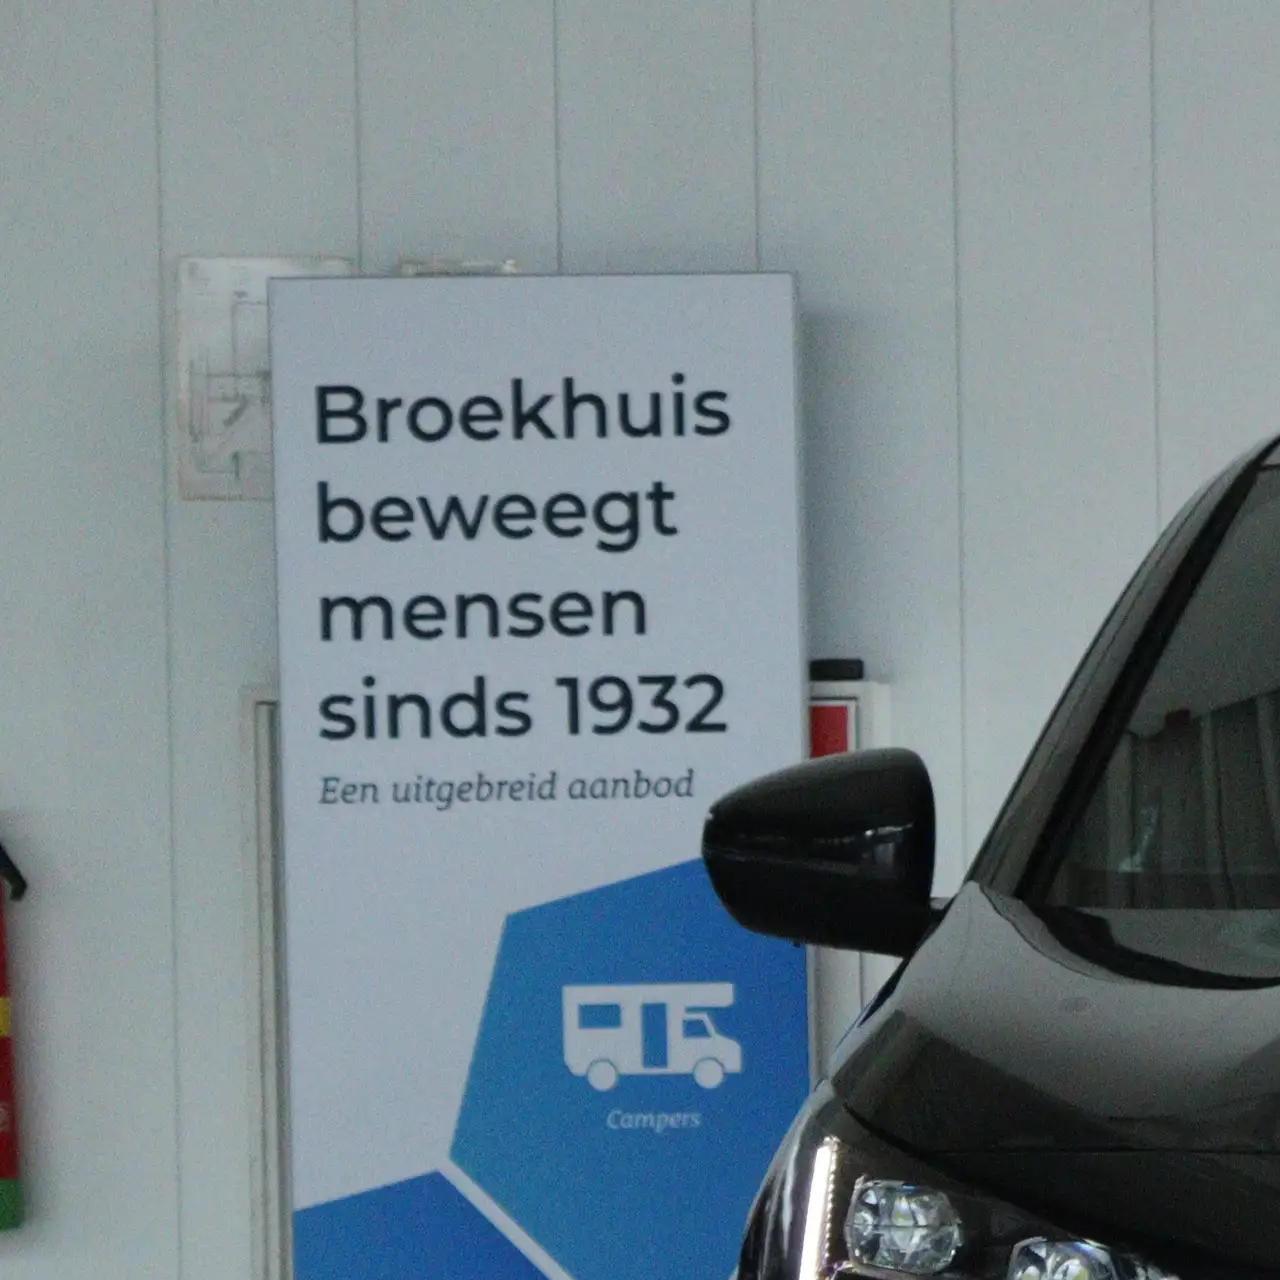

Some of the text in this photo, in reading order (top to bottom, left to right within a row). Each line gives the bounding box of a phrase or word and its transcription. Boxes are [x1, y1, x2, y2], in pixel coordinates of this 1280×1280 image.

[315, 373, 731, 444] Broekhuis
[317, 480, 678, 553] beweegt
[321, 590, 647, 642] mensen
[319, 673, 728, 740] sinds 1932
[319, 767, 695, 812] Een uitgebreid aanbod
[606, 1108, 701, 1133] Campers
